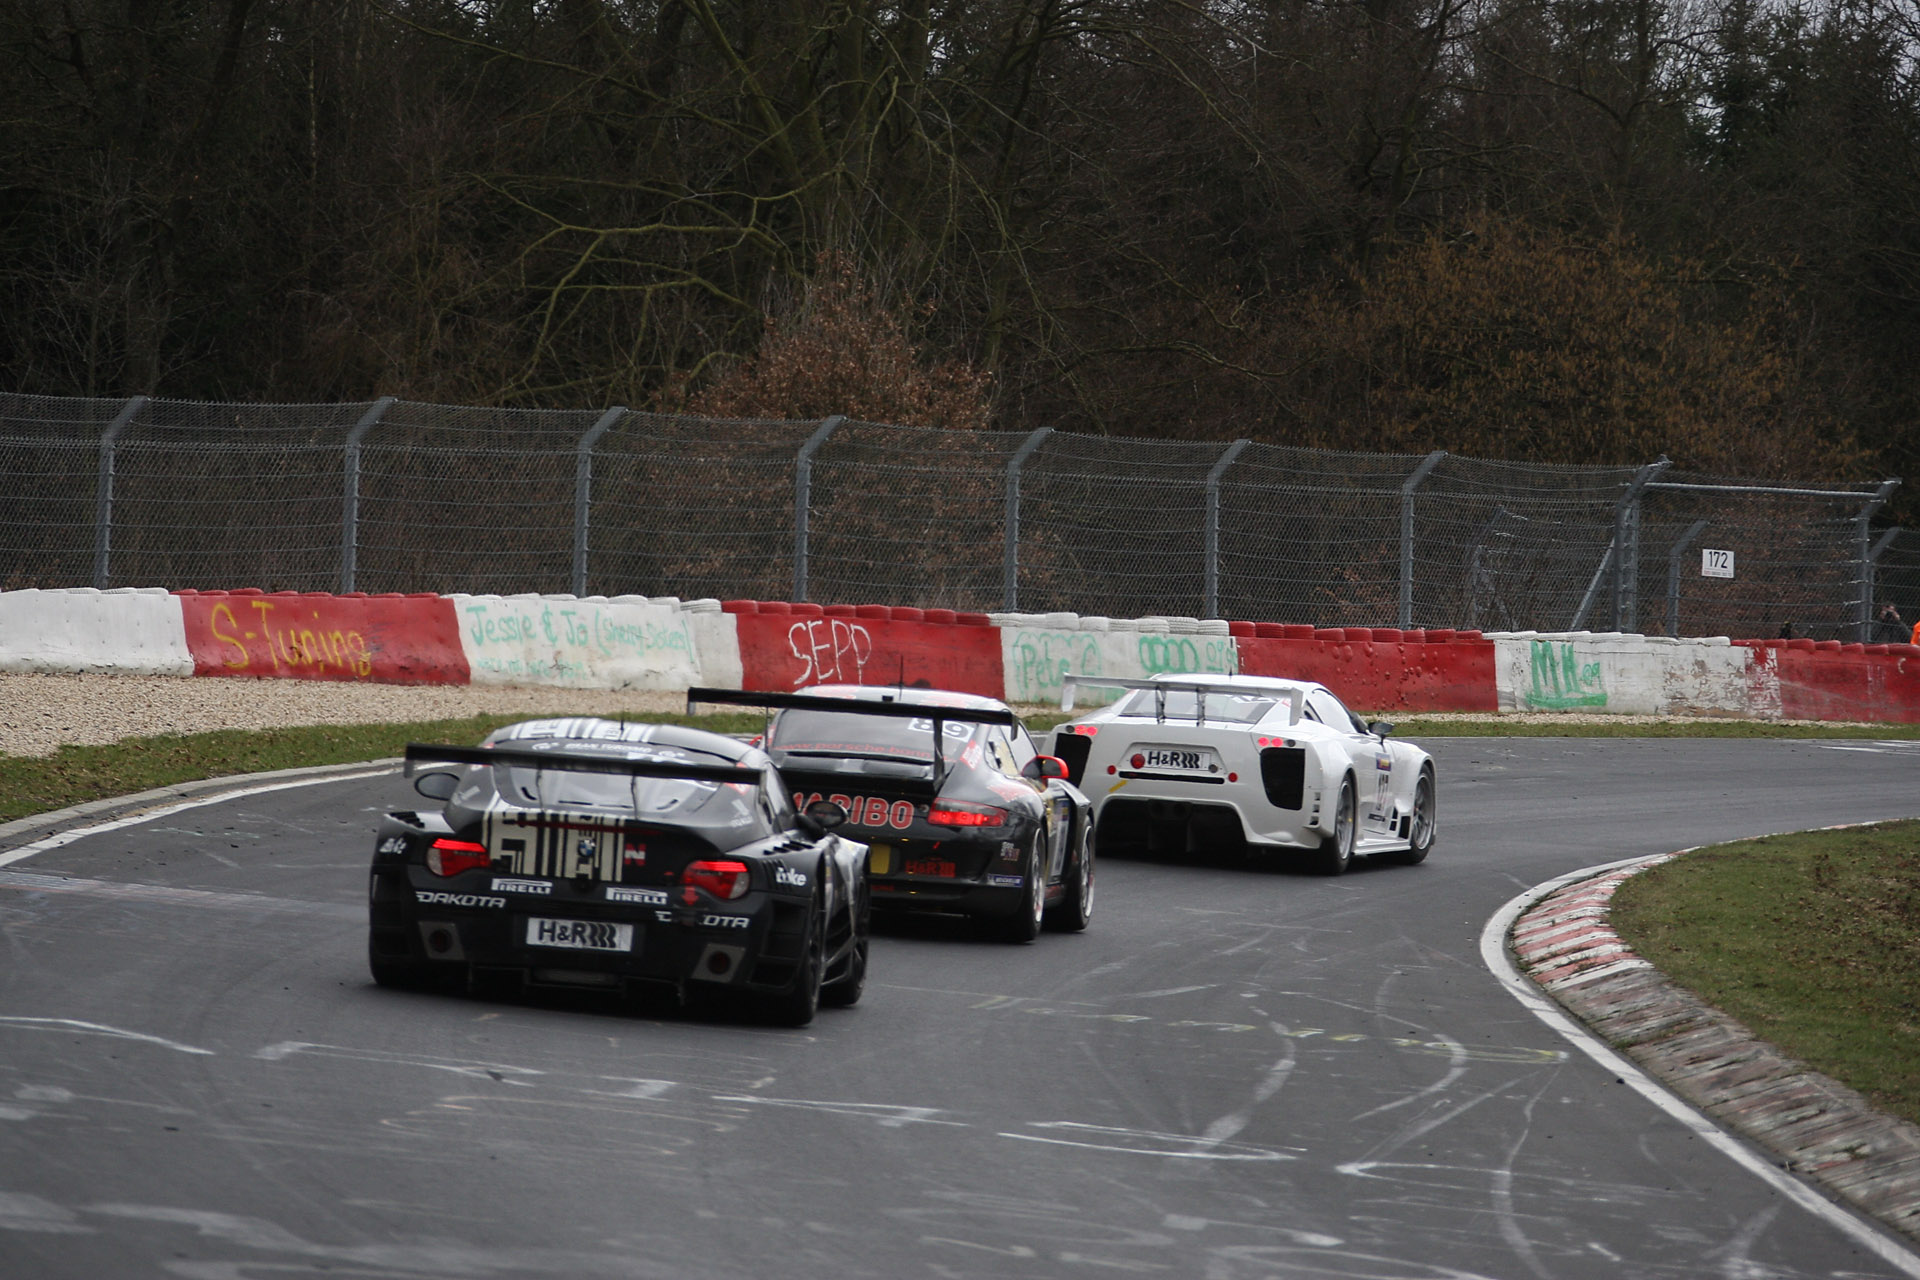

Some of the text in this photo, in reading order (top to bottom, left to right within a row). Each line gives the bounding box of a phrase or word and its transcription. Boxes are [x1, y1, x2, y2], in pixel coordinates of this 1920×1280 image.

[1708, 551, 1728, 568] 172
[466, 605, 537, 647] Jessie
[211, 600, 372, 676] S-Tuning
[788, 619, 872, 687] SEPP
[1148, 750, 1180, 767] H&R
[491, 877, 553, 895] PIRELLI
[606, 886, 668, 905] PIRELLI
[416, 891, 506, 908] DAKOTA
[538, 919, 588, 945] H&R
